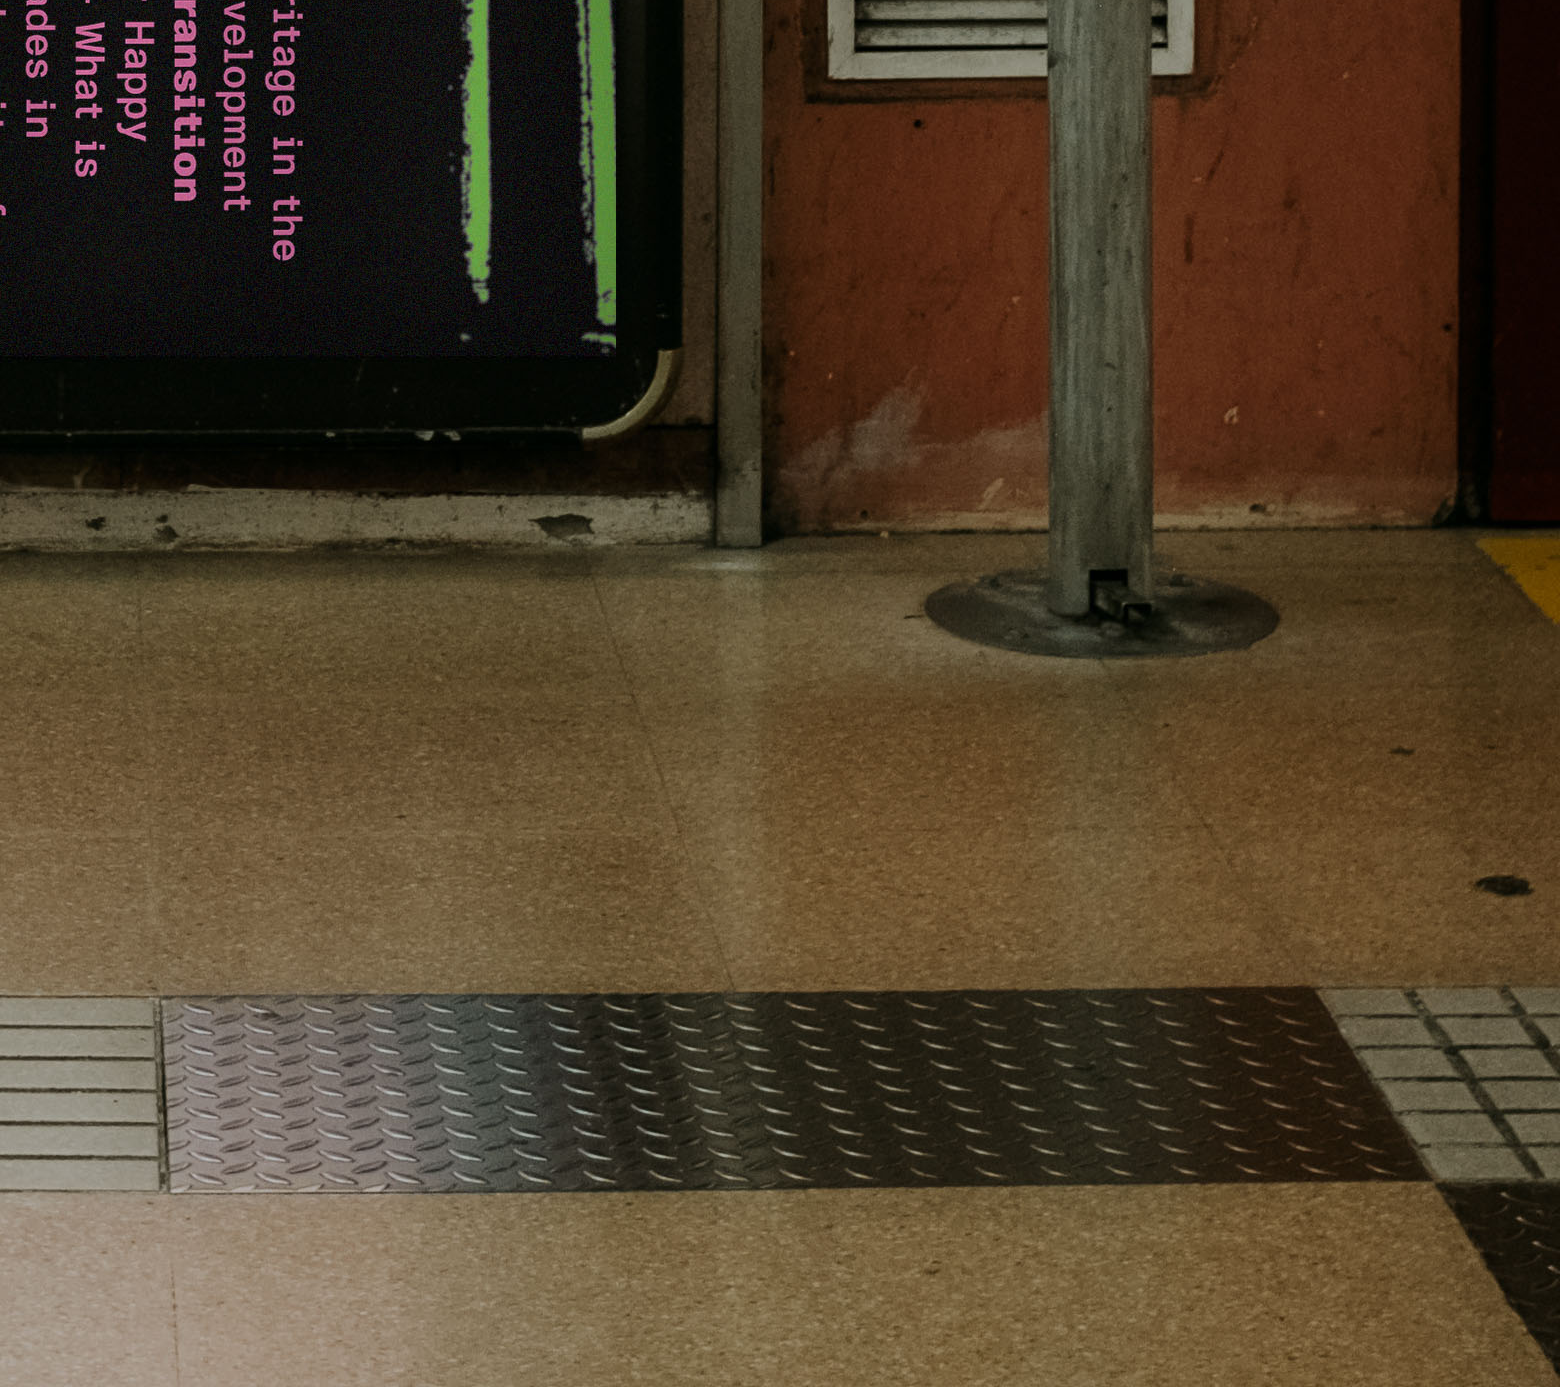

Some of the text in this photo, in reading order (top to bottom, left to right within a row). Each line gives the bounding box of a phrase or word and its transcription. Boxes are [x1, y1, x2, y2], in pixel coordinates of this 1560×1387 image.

[75, 23, 107, 119] What
[117, 23, 156, 142] Happy
[26, 101, 58, 138] in
[75, 142, 107, 178] is
[273, 138, 305, 175] in
[273, 197, 305, 261] the
